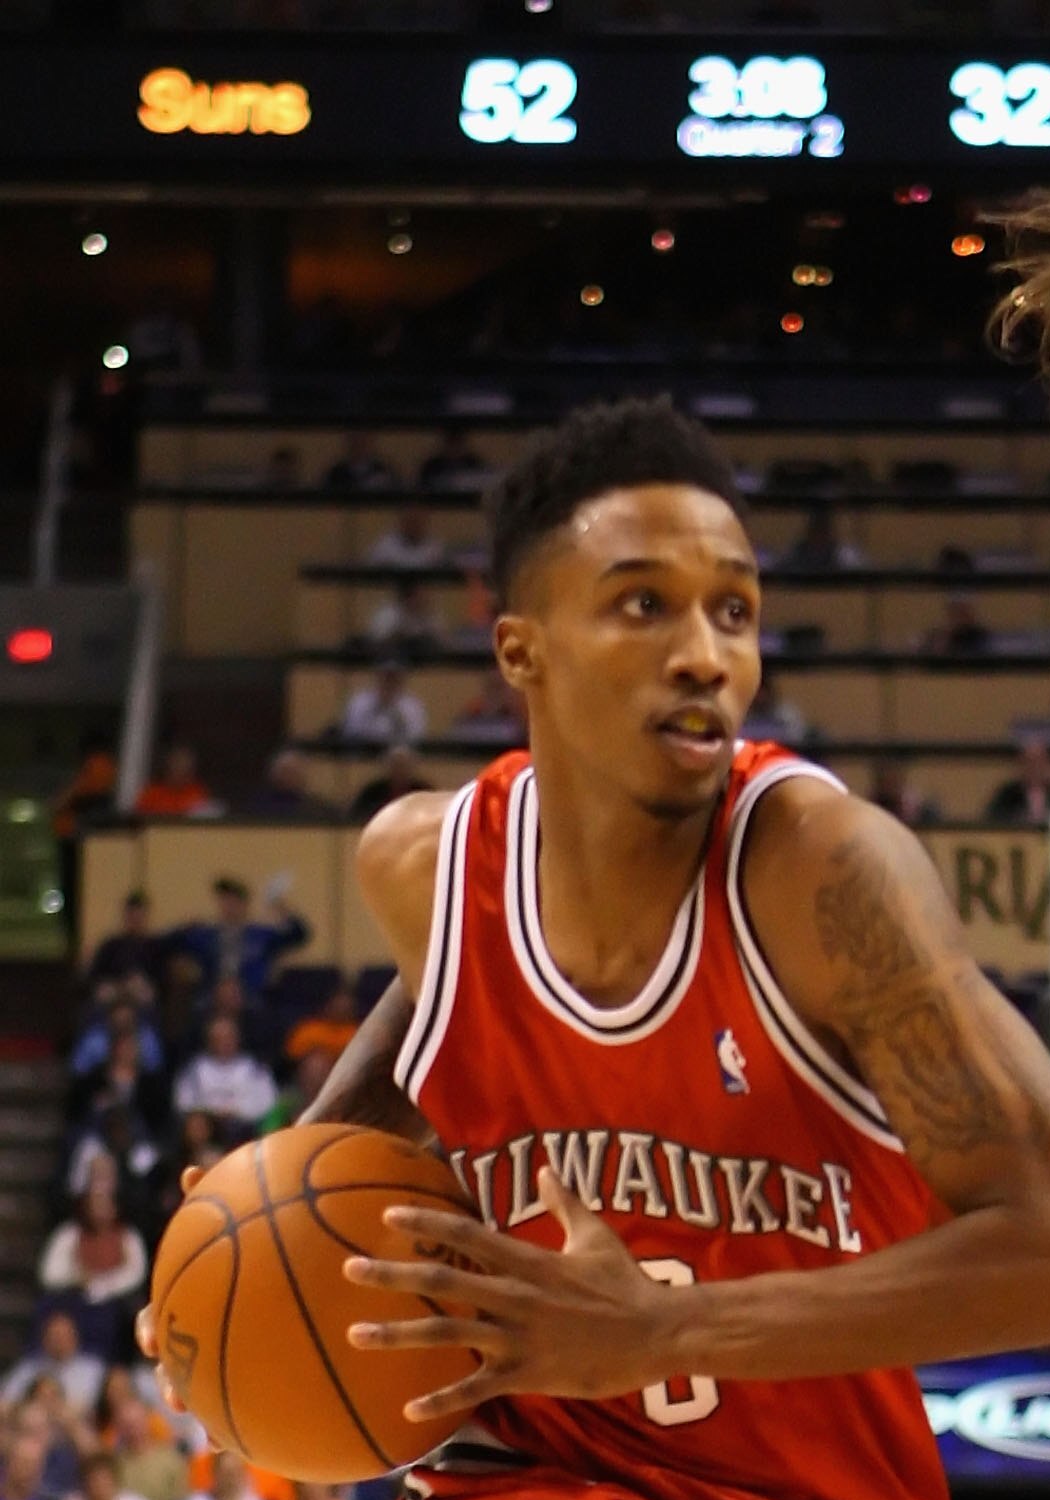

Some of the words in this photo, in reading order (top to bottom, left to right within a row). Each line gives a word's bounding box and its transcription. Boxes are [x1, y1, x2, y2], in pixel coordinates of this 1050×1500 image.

[138, 68, 311, 135] Suns
[459, 58, 577, 143] 52
[809, 114, 845, 158] 2
